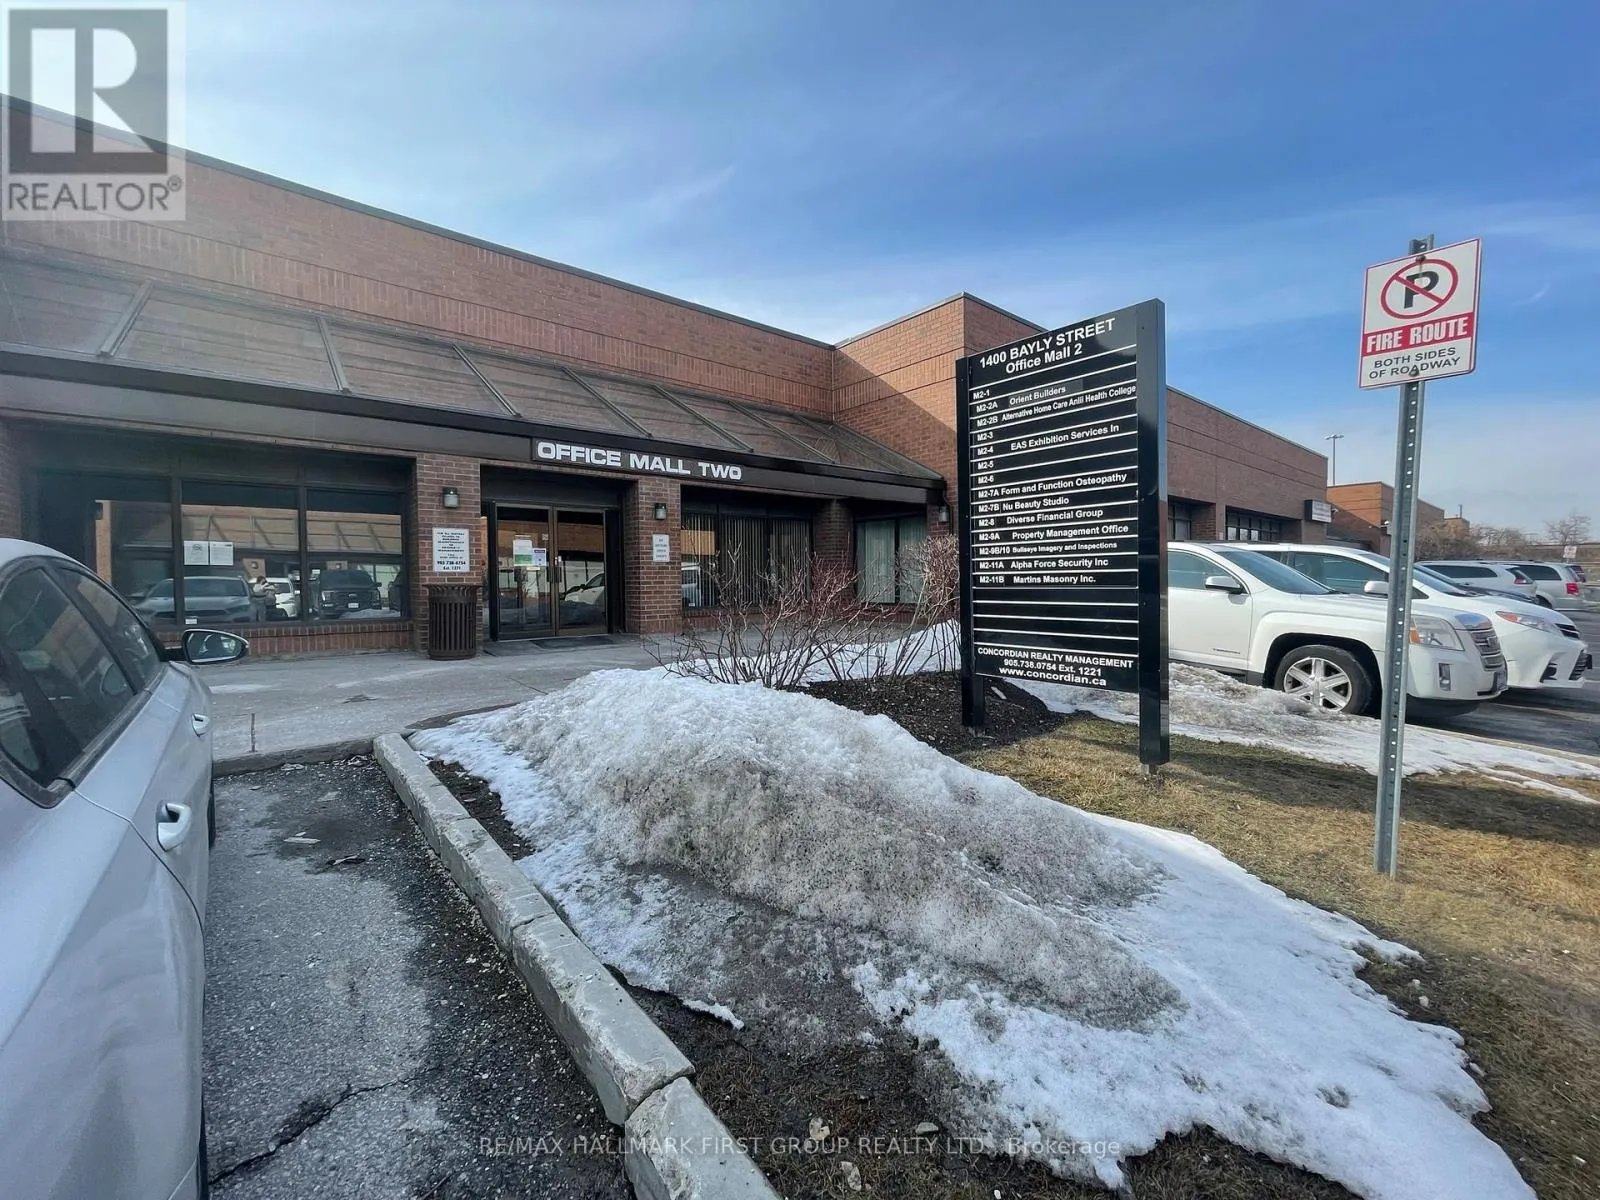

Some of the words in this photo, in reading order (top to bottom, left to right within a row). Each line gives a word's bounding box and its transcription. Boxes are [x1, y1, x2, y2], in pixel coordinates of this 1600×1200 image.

[980, 351, 1007, 368] 1400
[1010, 337, 1053, 360] BAYLY
[1056, 318, 1115, 346] STREET
[1366, 330, 1403, 353] FIRE
[1409, 317, 1469, 345] ROUTE
[1006, 357, 1041, 374] Office
[1044, 346, 1070, 363] Mall
[1074, 343, 1083, 356] 2
[1369, 369, 1386, 379] OF
[1390, 357, 1460, 377] ROADWAY
[1374, 355, 1410, 369] BOTH
[1415, 347, 1456, 362] SIDES
[973, 389, 990, 400] M2-1
[976, 401, 998, 413] M2-2A
[1009, 393, 1032, 405] Orient
[1033, 386, 1066, 399] Builders
[977, 416, 998, 427] M2-2B
[1002, 409, 1033, 421] Alternative
[1033, 405, 1052, 414] Home
[1053, 400, 1068, 409] Care
[1085, 391, 1107, 402] Health
[1109, 385, 1136, 397] College
[977, 446, 994, 456] M2-4
[1011, 441, 1027, 451] EAS
[1029, 434, 1069, 447] Exhibition
[1070, 426, 1108, 440] Services
[1110, 424, 1119, 432] In
[537, 441, 622, 467] OFFICE
[629, 453, 691, 475] MALL
[698, 462, 742, 480] TWO
[978, 489, 1000, 498] M2-7A
[1001, 486, 1020, 495] Form
[1022, 484, 1036, 493] and
[1038, 479, 1074, 491] Function
[1075, 473, 1127, 486] Osteopathy
[1003, 502, 1013, 511] Nu
[1015, 500, 1041, 509] Beauty
[1043, 497, 1069, 506] Studio
[1006, 515, 1035, 524] Diverse
[1037, 511, 1074, 521] Financial
[1075, 510, 1103, 518] Group
[1012, 531, 1044, 540] Property
[1046, 526, 1100, 537] Management
[1101, 525, 1129, 533] Office
[1078, 542, 1118, 550] Inspections
[1011, 561, 1032, 570] Alpha
[1034, 560, 1056, 568] Force
[1058, 558, 1093, 568] Security
[1094, 558, 1109, 566] Inc
[1013, 576, 1041, 584] Martins
[1043, 575, 1078, 584] Masonry
[1080, 574, 1096, 583] Inc.
[978, 647, 1029, 659] CONCORDIAN
[1031, 652, 1063, 662] REALTY
[1065, 655, 1134, 668] MANAGEMENT
[1004, 658, 1056, 671] 905.738.0754
[1059, 664, 1076, 673] Ext.
[1079, 667, 1102, 677] 1221
[999, 666, 1106, 686] www.concordian.ca
